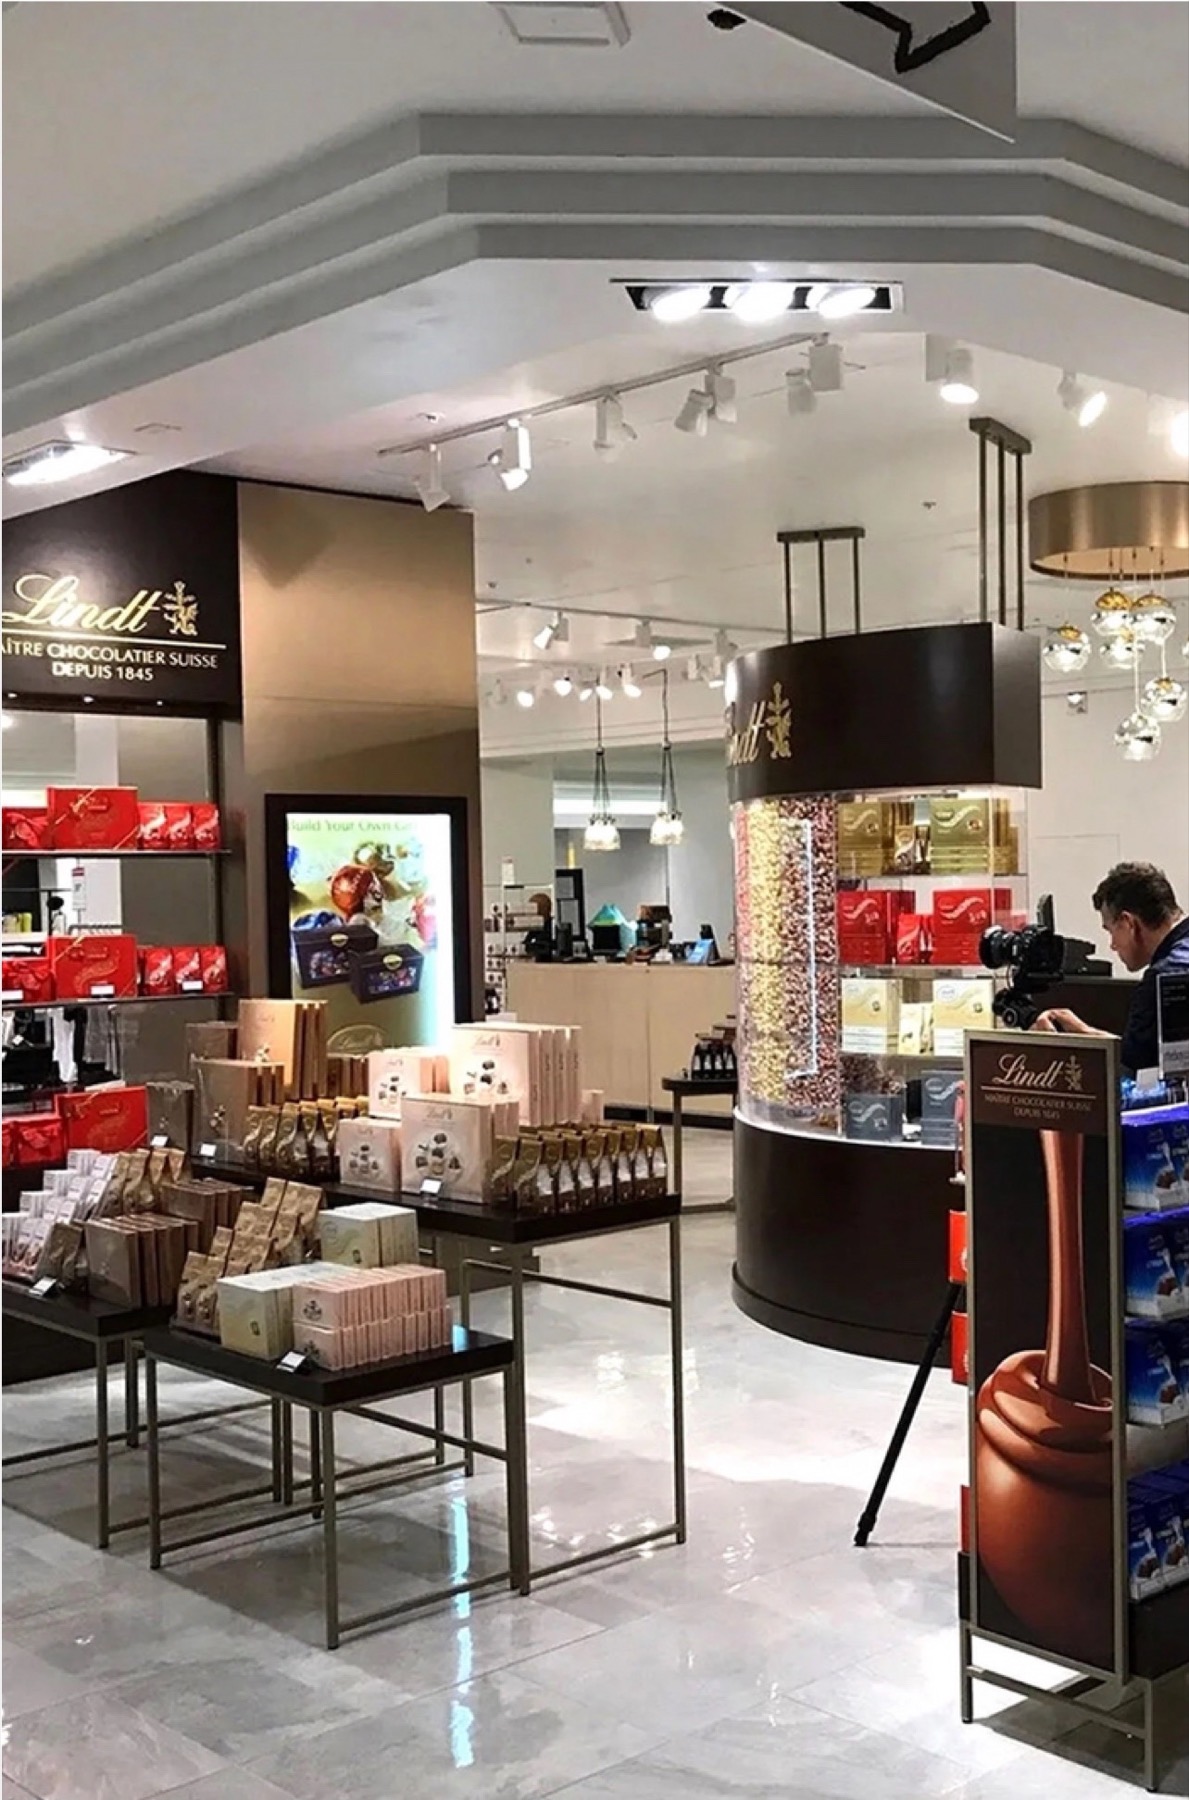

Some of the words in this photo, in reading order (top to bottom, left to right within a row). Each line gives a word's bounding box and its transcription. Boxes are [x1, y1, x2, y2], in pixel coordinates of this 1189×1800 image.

[2, 574, 162, 633] Lindt
[47, 642, 166, 665] CHOCOLATIER
[169, 652, 218, 669] SUISSE
[52, 661, 112, 681] DEPUIS
[117, 666, 153, 681] 1845
[324, 819, 354, 832] Your
[358, 819, 392, 832] Own
[993, 1054, 1064, 1087] Lindt
